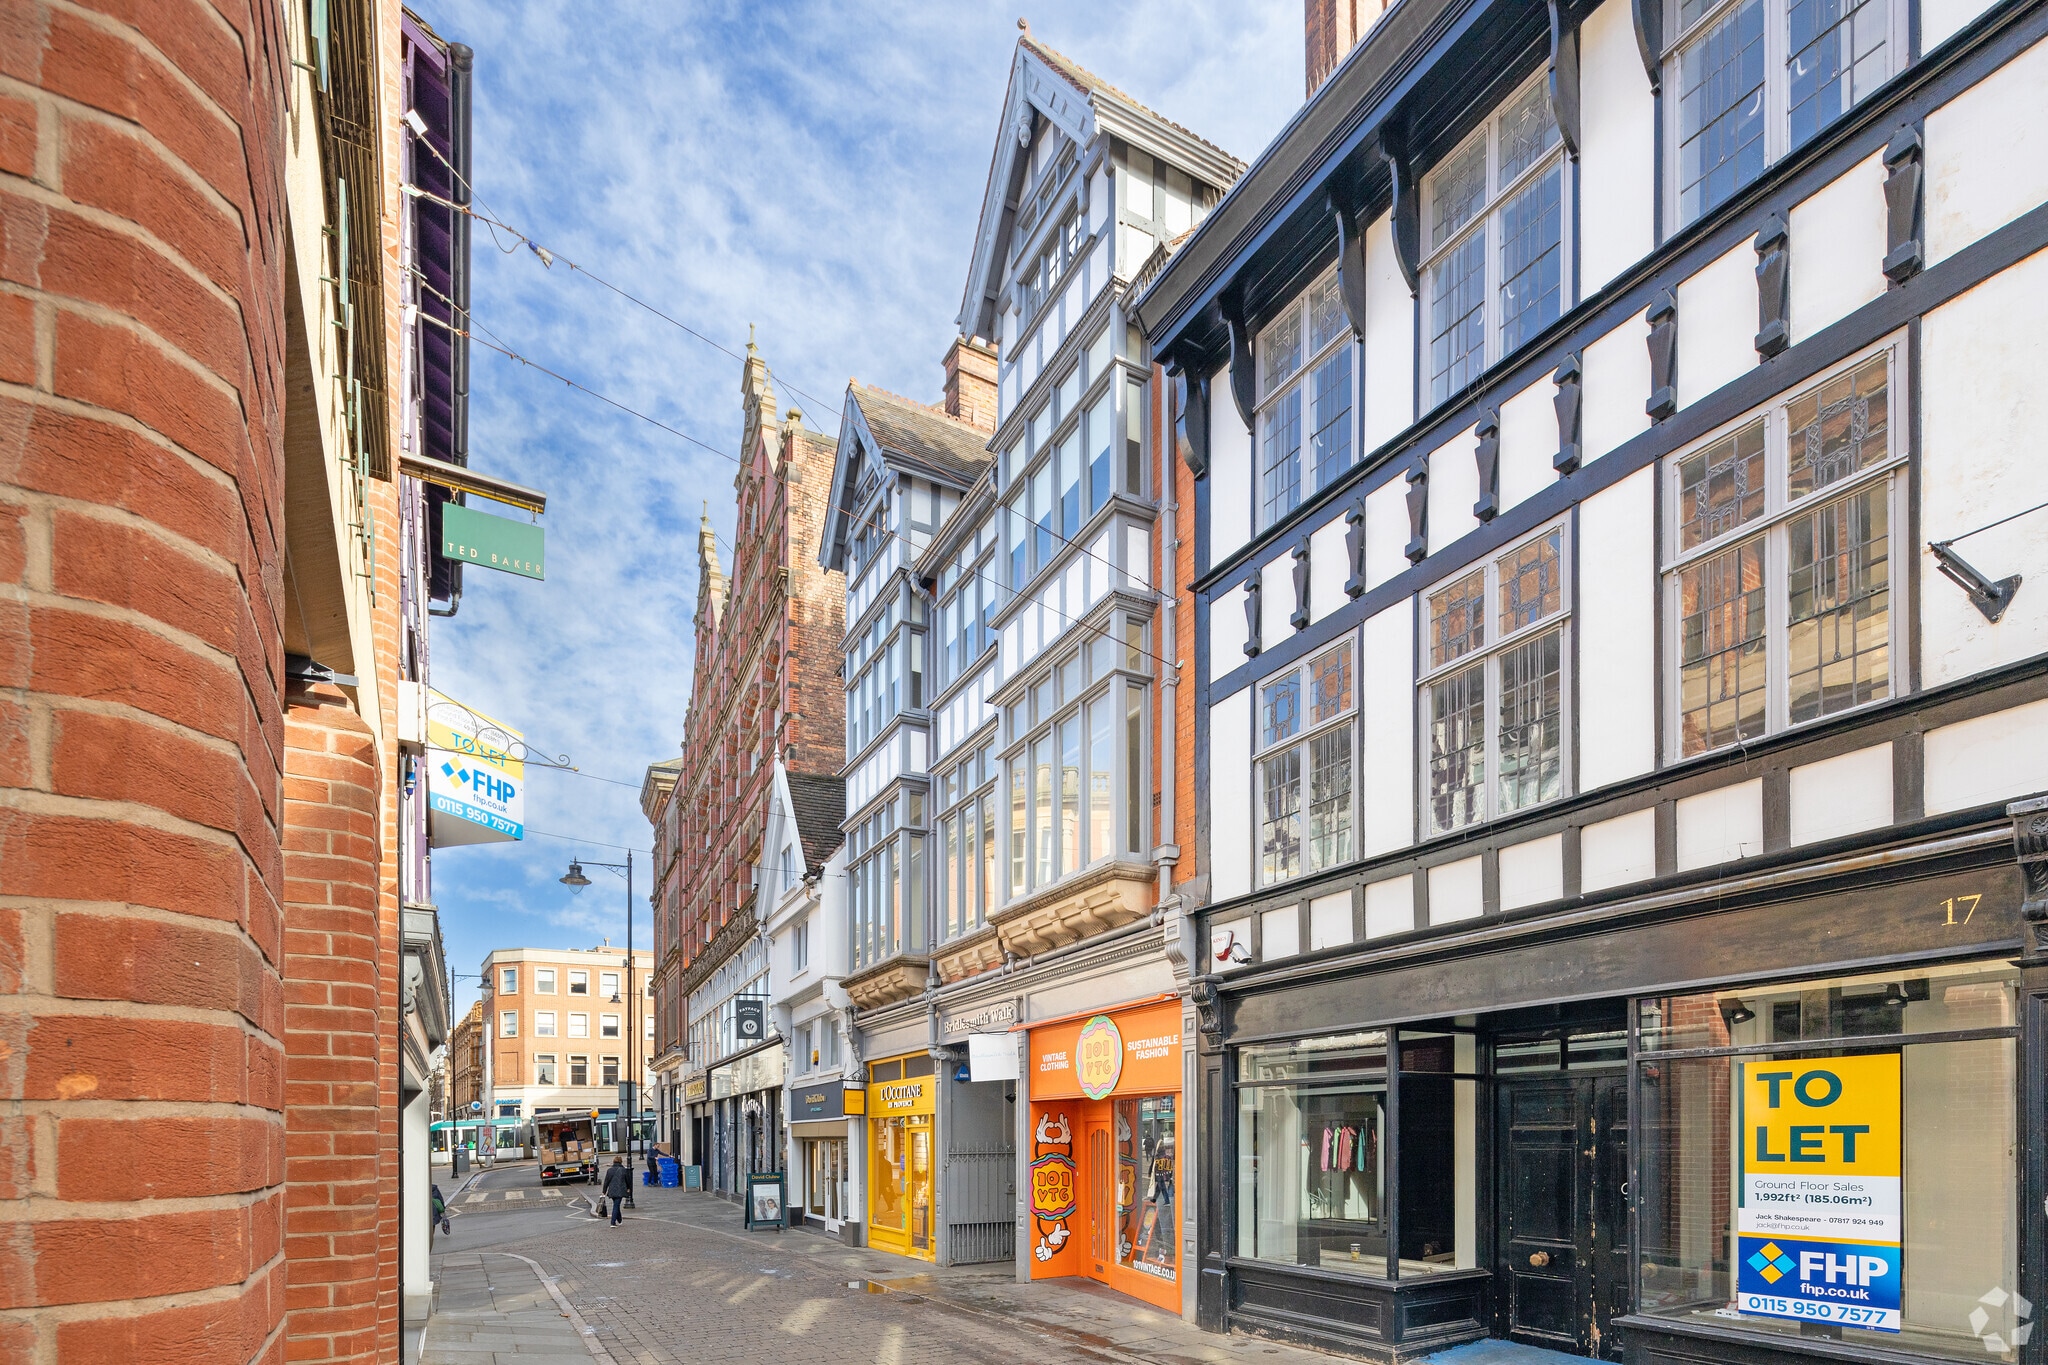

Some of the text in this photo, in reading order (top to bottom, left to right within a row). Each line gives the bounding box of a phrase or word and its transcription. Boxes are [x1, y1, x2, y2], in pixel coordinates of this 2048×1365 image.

[448, 542, 541, 574] TED BAKER
[451, 732, 507, 767] TO LET
[473, 768, 516, 804] FHP
[473, 793, 508, 814] fhp.co.uk
[437, 797, 517, 834] 0115 950 7577
[1940, 894, 1982, 926] 17
[944, 1006, 1014, 1034] Bridlesmith Walk
[1085, 1040, 1110, 1059] 101
[1127, 1034, 1179, 1051] SUSTAINABLE
[1042, 1051, 1067, 1063] VINTAGE
[1135, 1047, 1169, 1060] FASHION
[1040, 1060, 1069, 1072] CLOTHING
[1086, 1059, 1112, 1077] VTG
[1756, 1069, 1843, 1109] TO
[1756, 1125, 1870, 1163] LET
[1037, 1171, 1070, 1187] 101
[1754, 1180, 1864, 1192] Ground Floor Sales
[1037, 1187, 1070, 1203] VTG
[1804, 1193, 1872, 1207] (185.06m²)
[1755, 1221, 1810, 1231] jack@fhp.co.uk
[1774, 1214, 1822, 1223] Shakespeare
[1800, 1250, 1889, 1287] FHP
[1800, 1282, 1870, 1301] fhp.co.uk
[1748, 1296, 1887, 1324] 0115 950 7577
